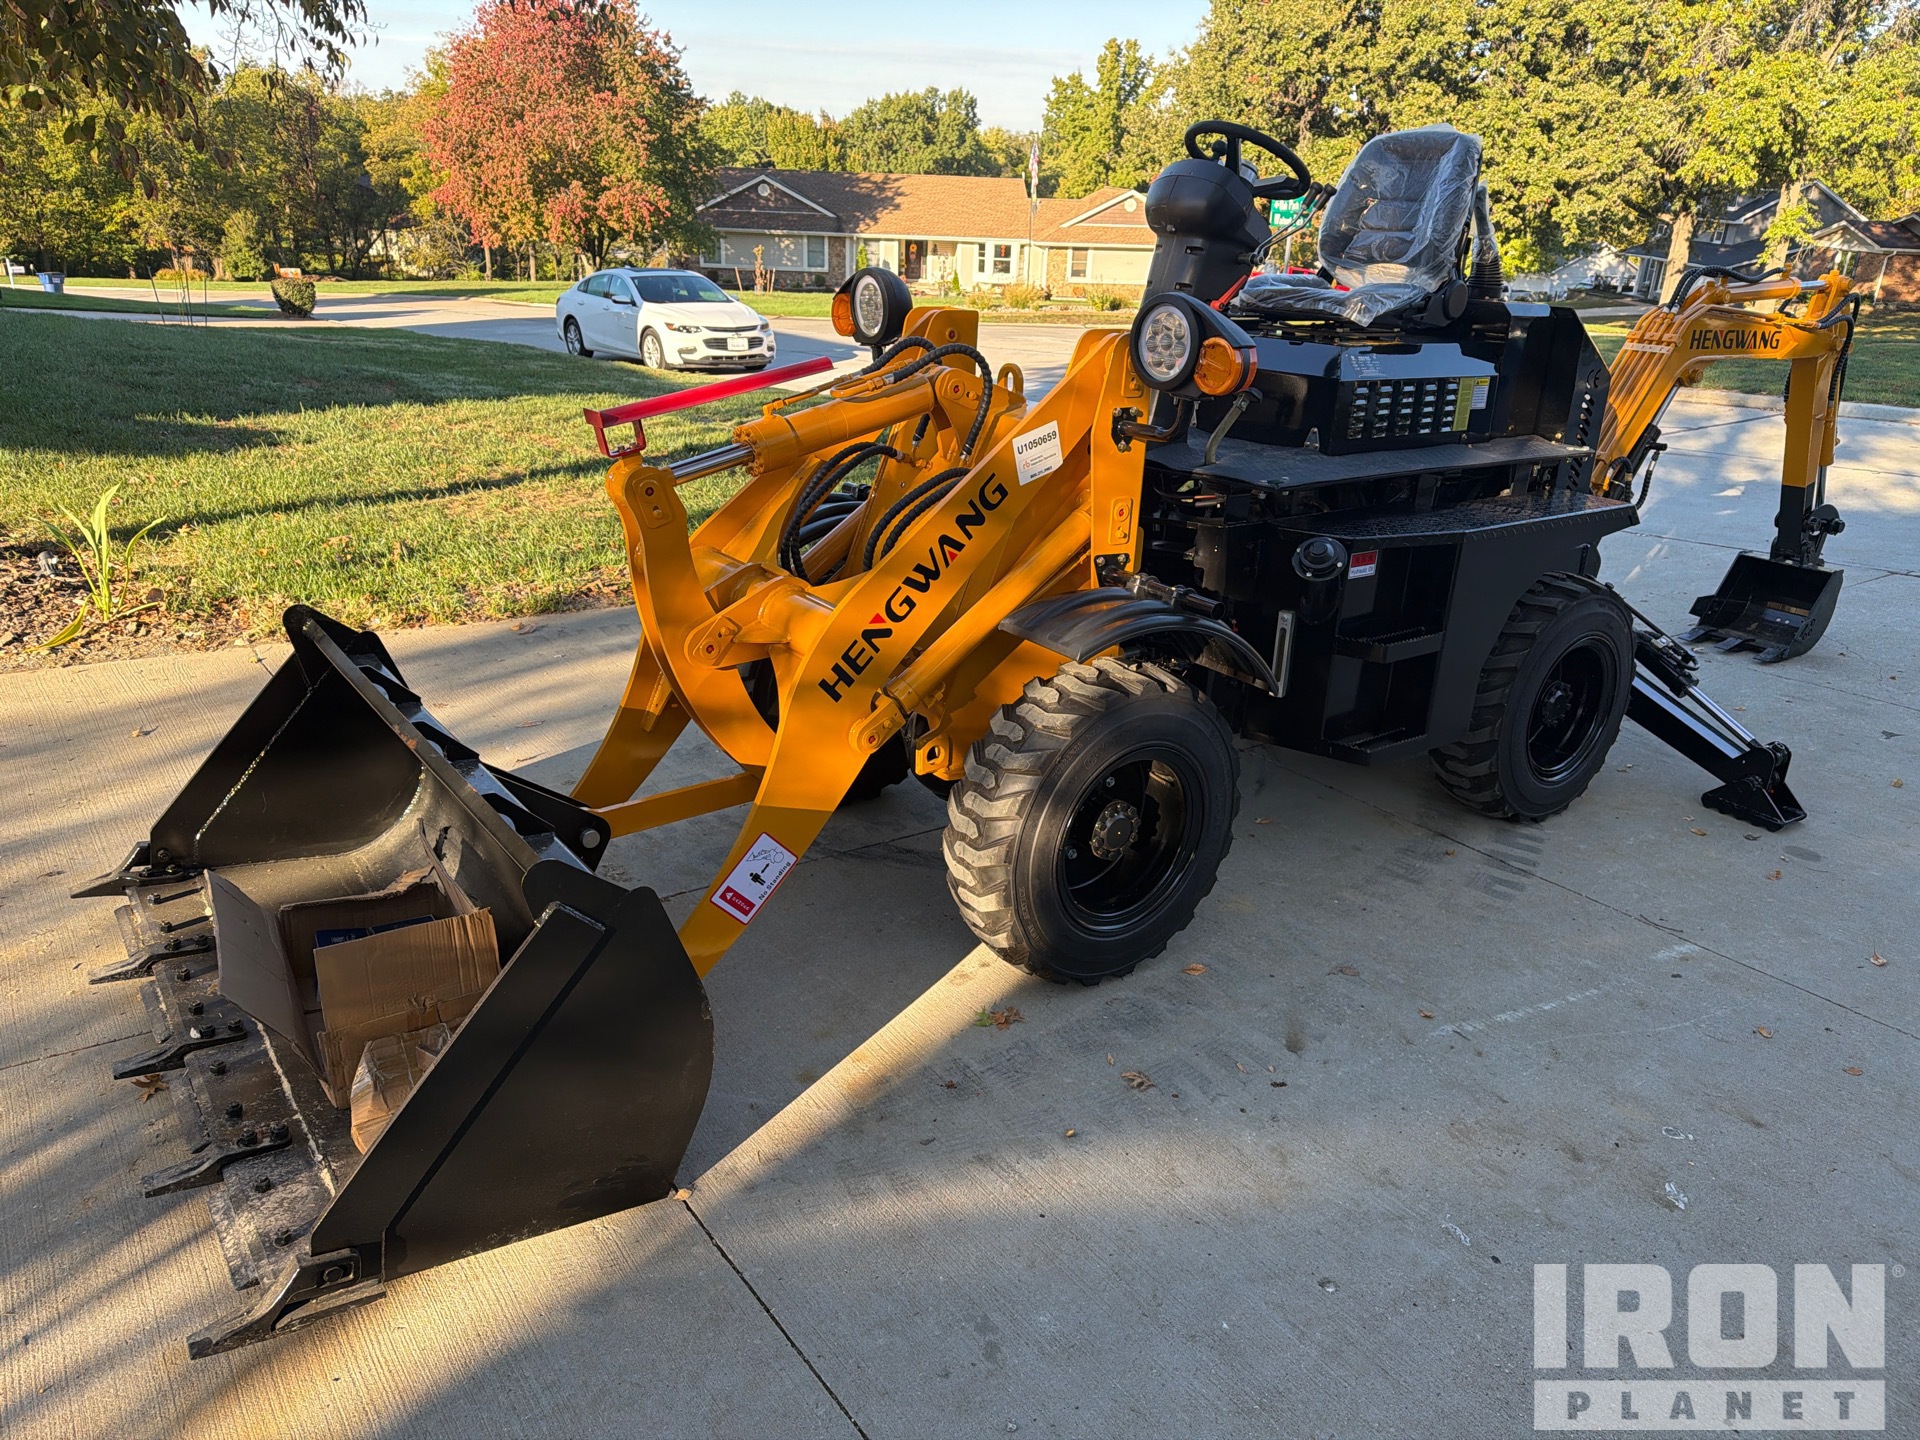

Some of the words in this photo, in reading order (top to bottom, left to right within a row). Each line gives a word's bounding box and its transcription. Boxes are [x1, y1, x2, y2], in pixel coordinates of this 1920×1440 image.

[1689, 329, 1782, 350] HENGWANG
[1017, 430, 1057, 455] U1050659
[818, 472, 1009, 703] HENGWANG
[758, 891, 768, 901] No
[766, 861, 791, 891] Standing
